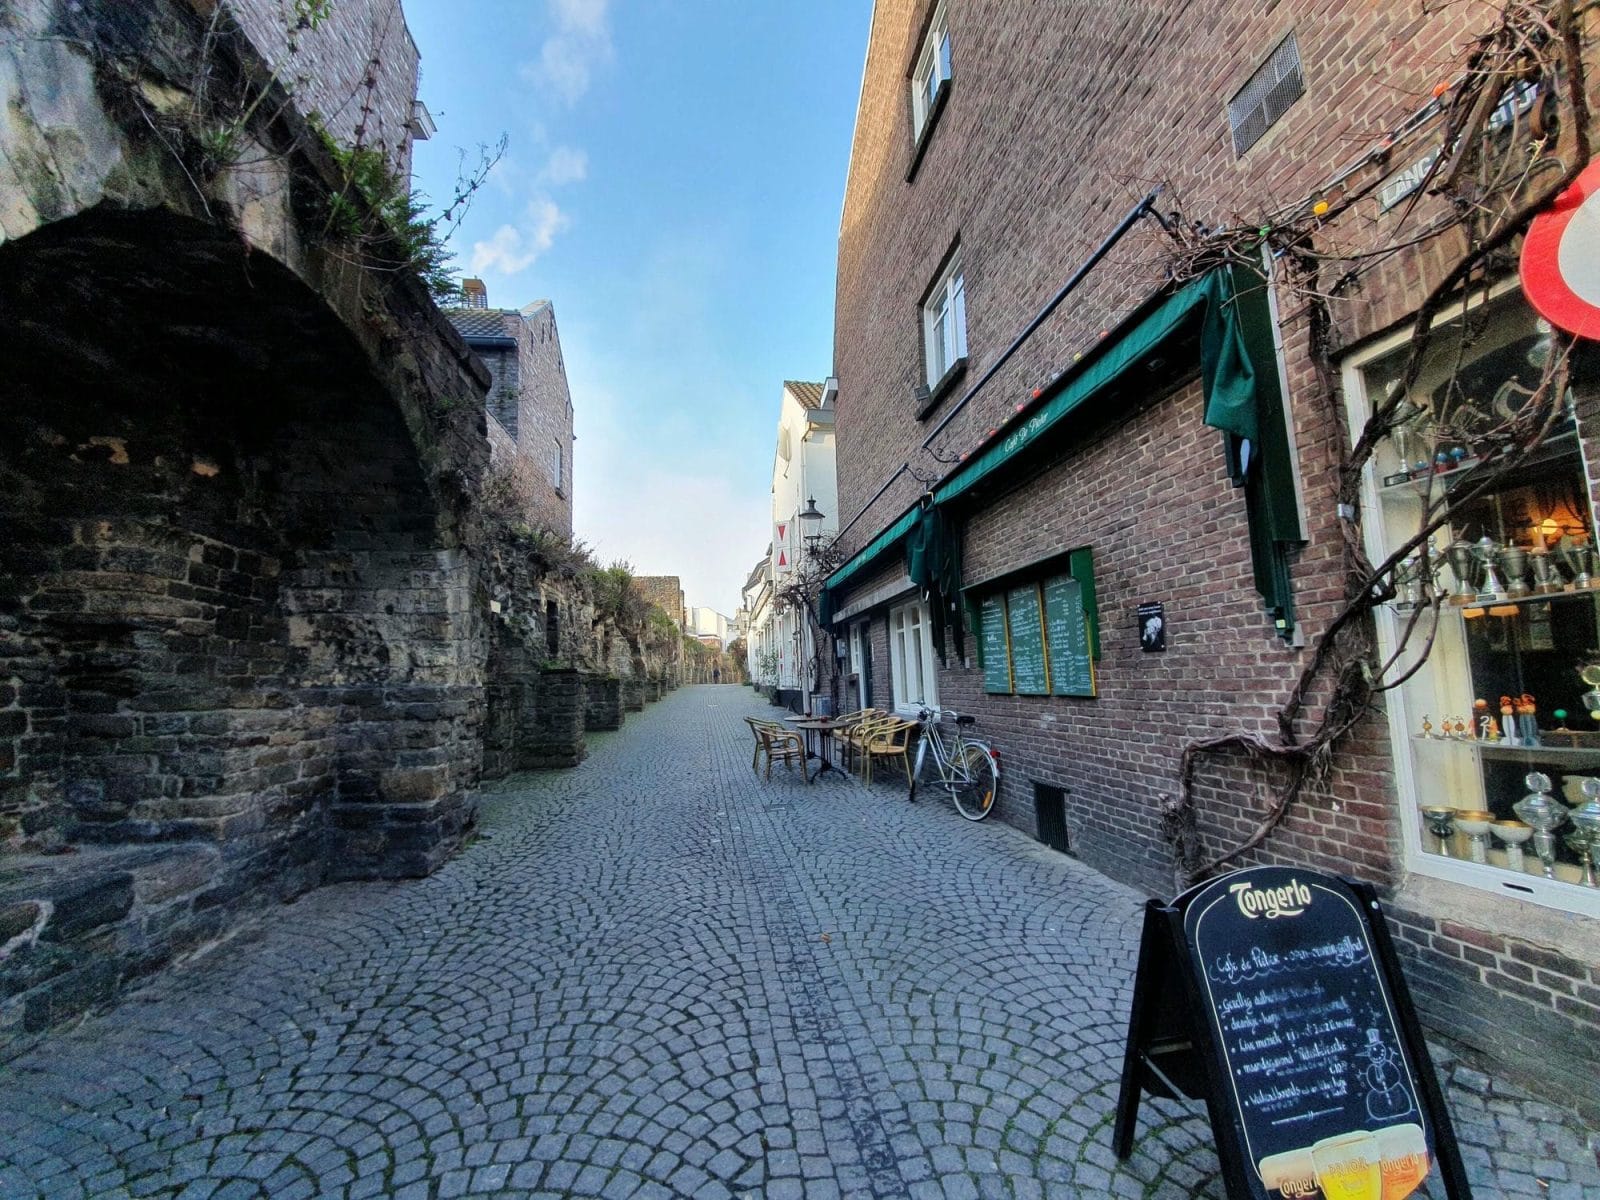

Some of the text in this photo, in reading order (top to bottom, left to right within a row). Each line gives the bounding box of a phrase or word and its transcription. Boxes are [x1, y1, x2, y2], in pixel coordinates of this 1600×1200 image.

[1229, 878, 1311, 919] Tongerlo
[1382, 1150, 1419, 1177] ongerlo
[1276, 1173, 1317, 1199] Tongerl
